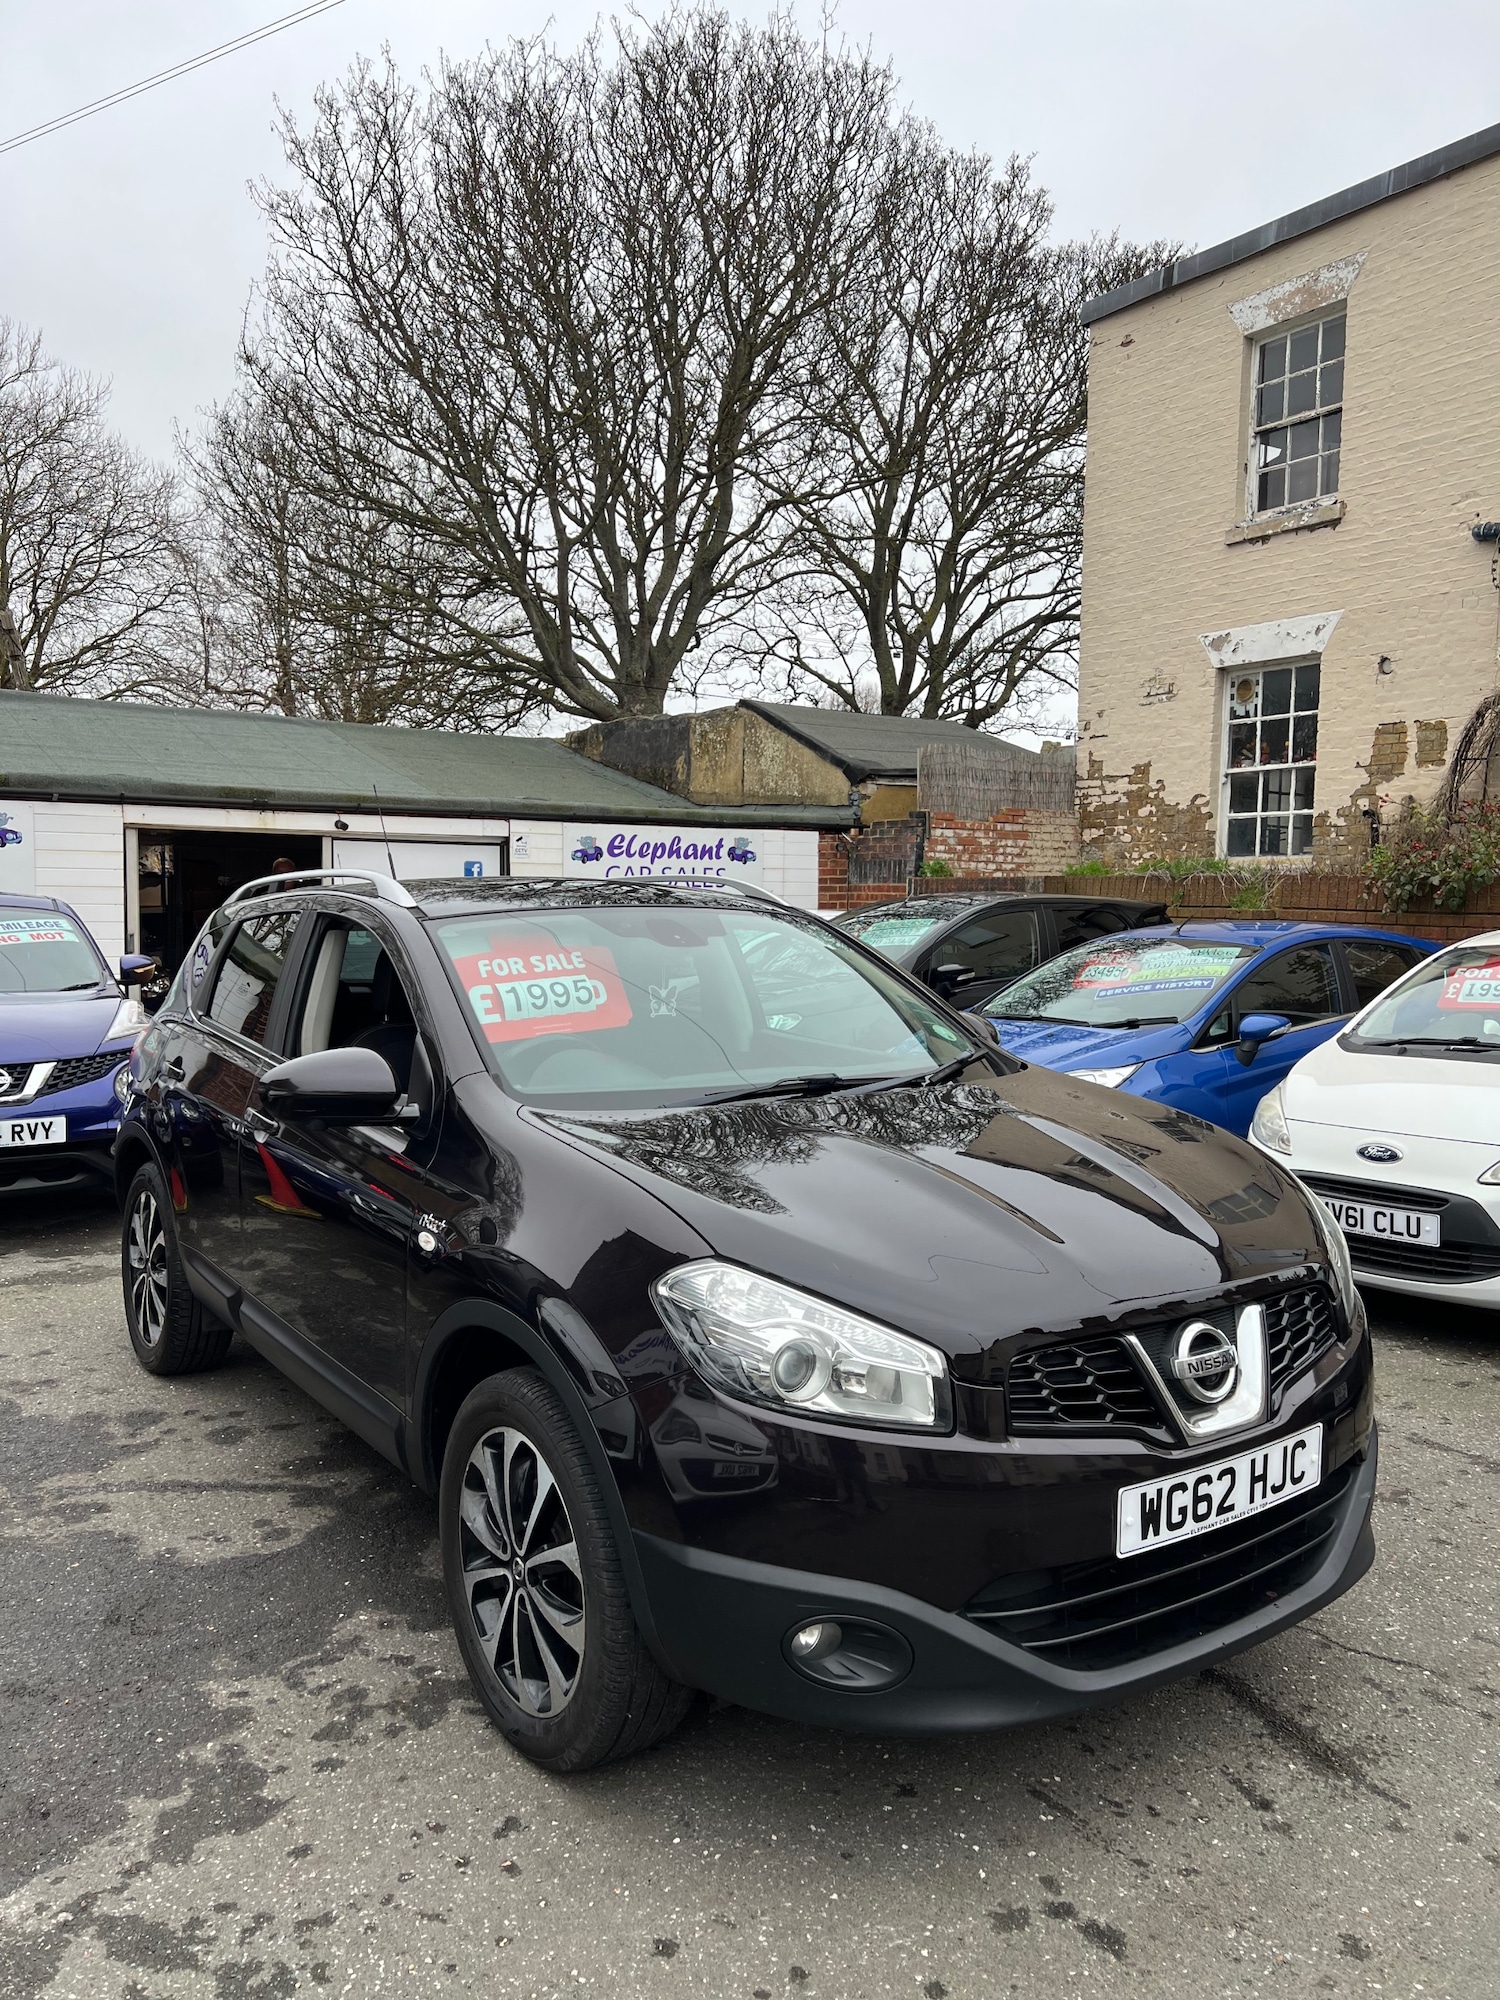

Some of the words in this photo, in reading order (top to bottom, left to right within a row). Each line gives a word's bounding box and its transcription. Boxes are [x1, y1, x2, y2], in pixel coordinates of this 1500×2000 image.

[606, 833, 724, 865] Elephant
[0, 920, 64, 931] MILEAGE
[28, 931, 65, 941] MOT
[478, 956, 528, 978] FOR
[529, 951, 586, 973] SALE
[1453, 967, 1493, 979] FOR
[1099, 984, 1152, 997] SERVICE
[1155, 980, 1212, 991] HISTORY
[11, 1121, 54, 1142] RVY
[1364, 1145, 1392, 1160] Ford
[1324, 1201, 1364, 1230] V61
[1373, 1210, 1421, 1239] CLU
[1187, 1350, 1236, 1374] NISSAN
[1140, 1466, 1237, 1541] WG62
[1249, 1439, 1307, 1505] HJC
[1190, 1521, 1218, 1535] ELEPHANT
[1220, 1517, 1230, 1525] CAR
[1231, 1510, 1246, 1520] SALES
